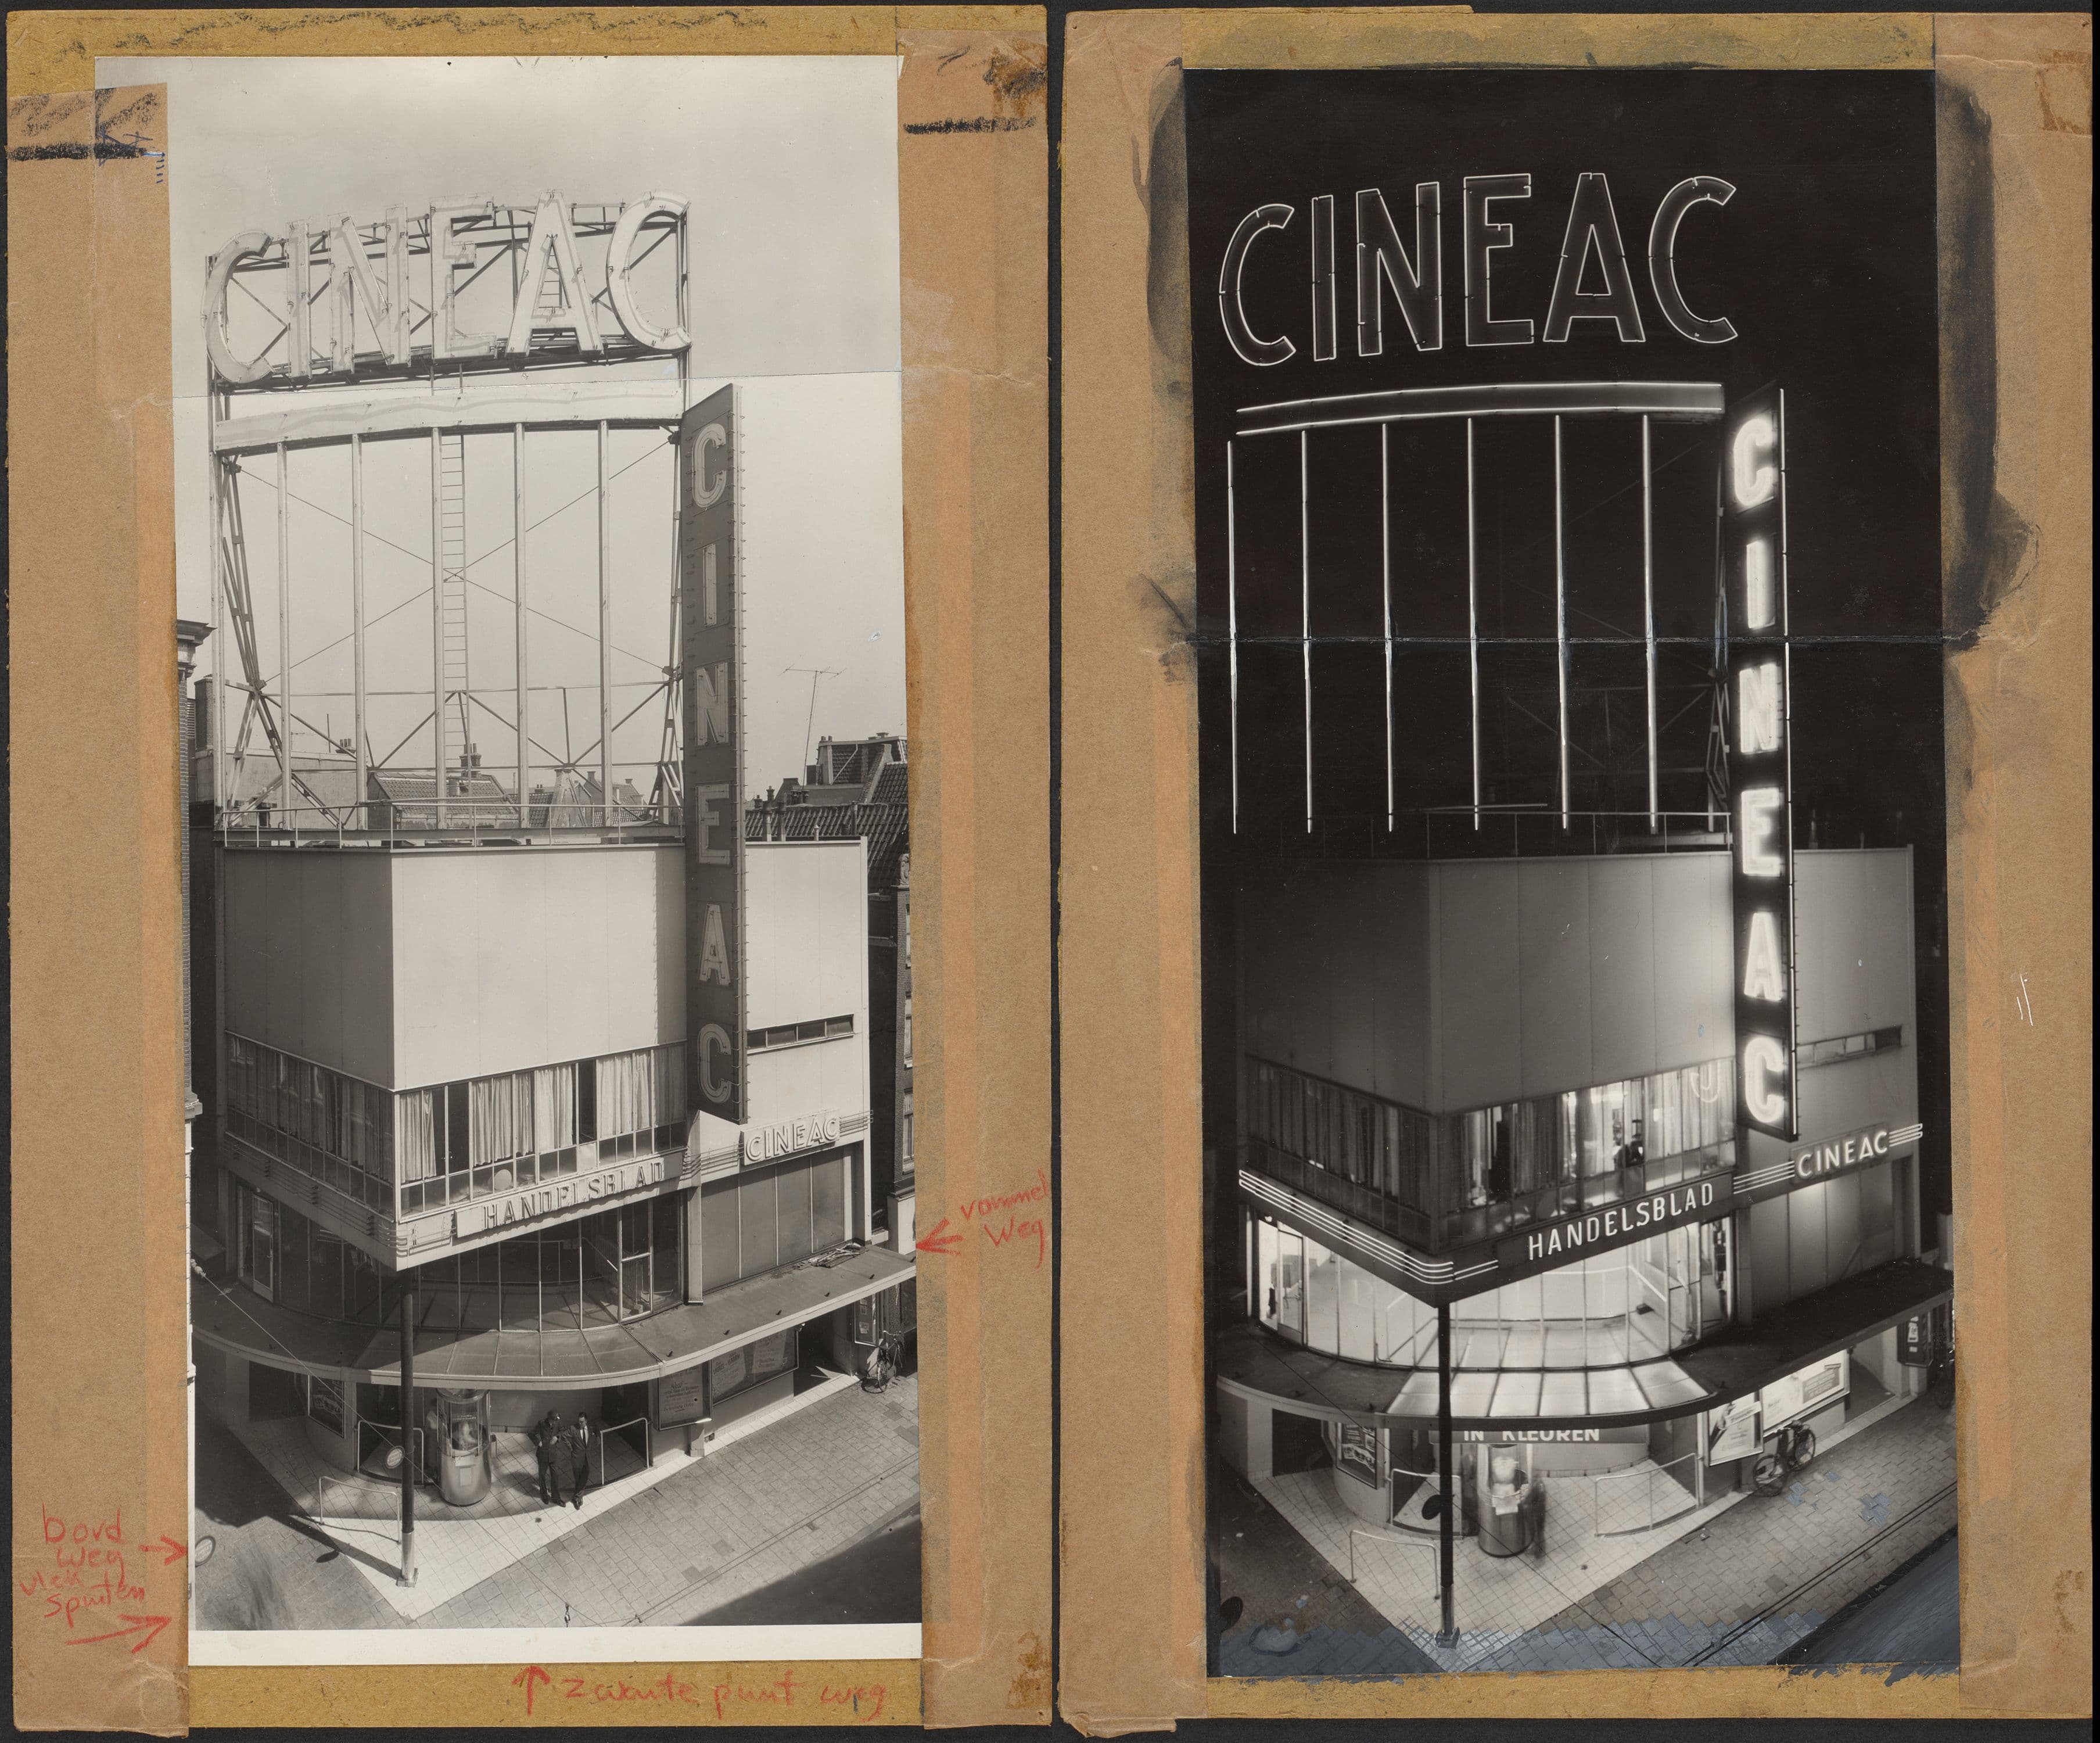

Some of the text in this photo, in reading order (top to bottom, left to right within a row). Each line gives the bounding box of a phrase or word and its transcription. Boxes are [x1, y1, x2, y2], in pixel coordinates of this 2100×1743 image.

[200, 189, 692, 384] CINEAC
[1219, 172, 1739, 367] CINEAC
[692, 423, 731, 1103] CINEAC
[1733, 418, 1785, 1124] CINEAC
[746, 1117, 840, 1163] CINEAC
[1798, 1130, 1889, 1177] CINEAC
[483, 1160, 666, 1230] HANDELSBLAD
[1528, 1182, 1714, 1261] HANDELSBLAD
[1464, 1429, 1600, 1441] IN KLEUREN
